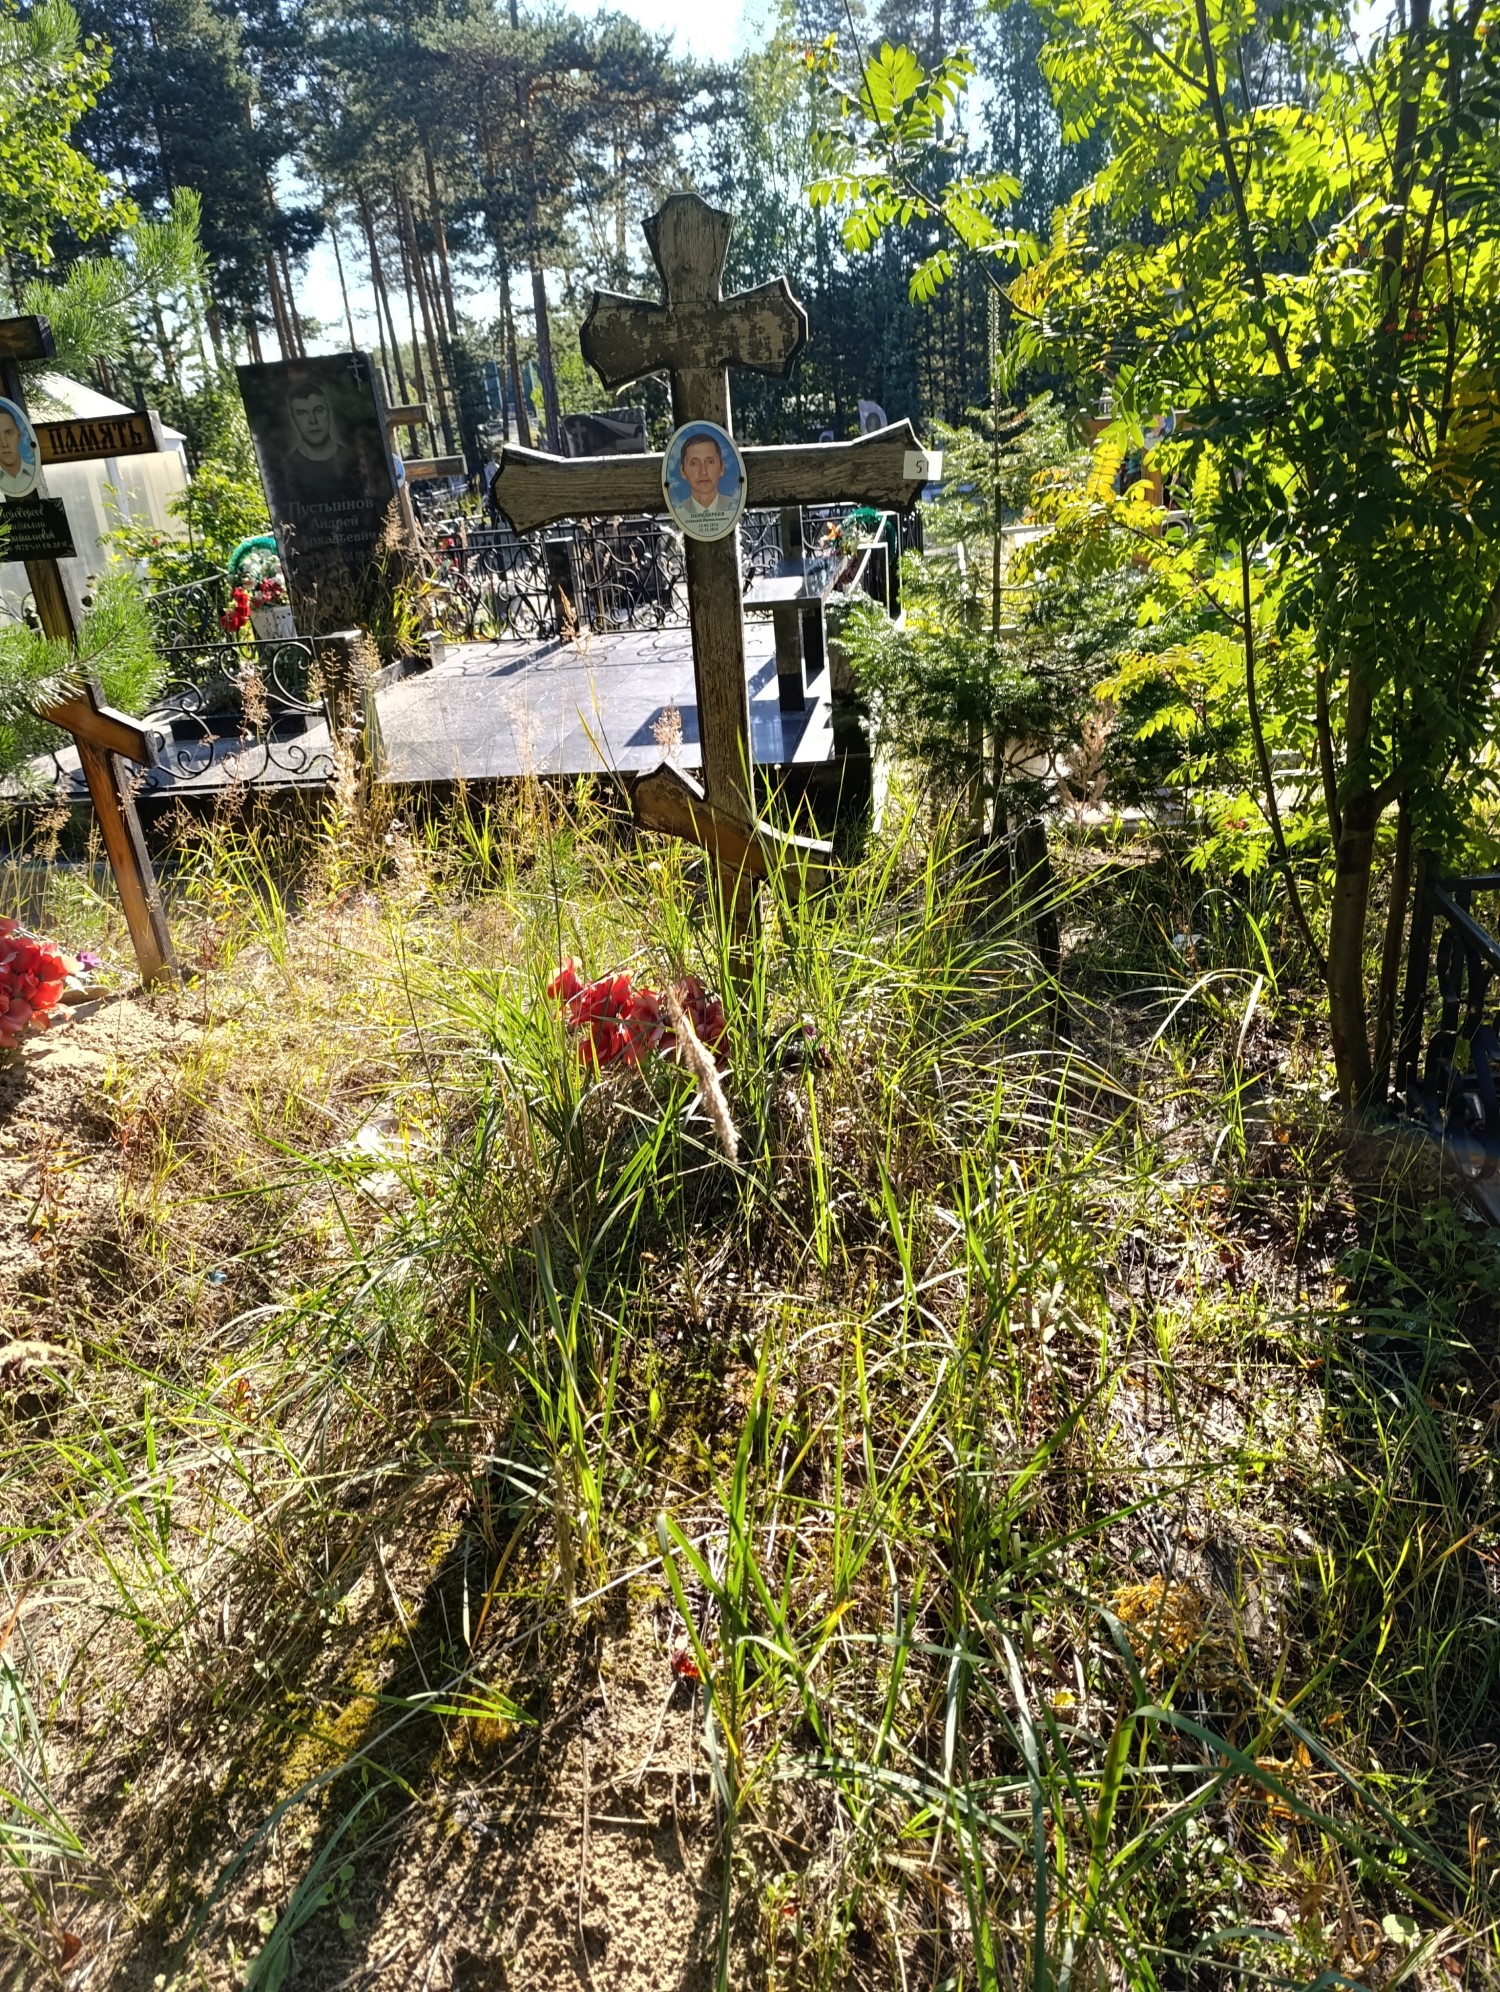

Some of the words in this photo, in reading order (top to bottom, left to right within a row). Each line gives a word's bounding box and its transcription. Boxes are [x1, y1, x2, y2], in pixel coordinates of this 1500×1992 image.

[48, 420, 143, 455] ПАМЯТЬ
[289, 499, 374, 517] Пустыннов
[311, 516, 359, 529] Андрей
[299, 532, 376, 547] Аркадьевич
